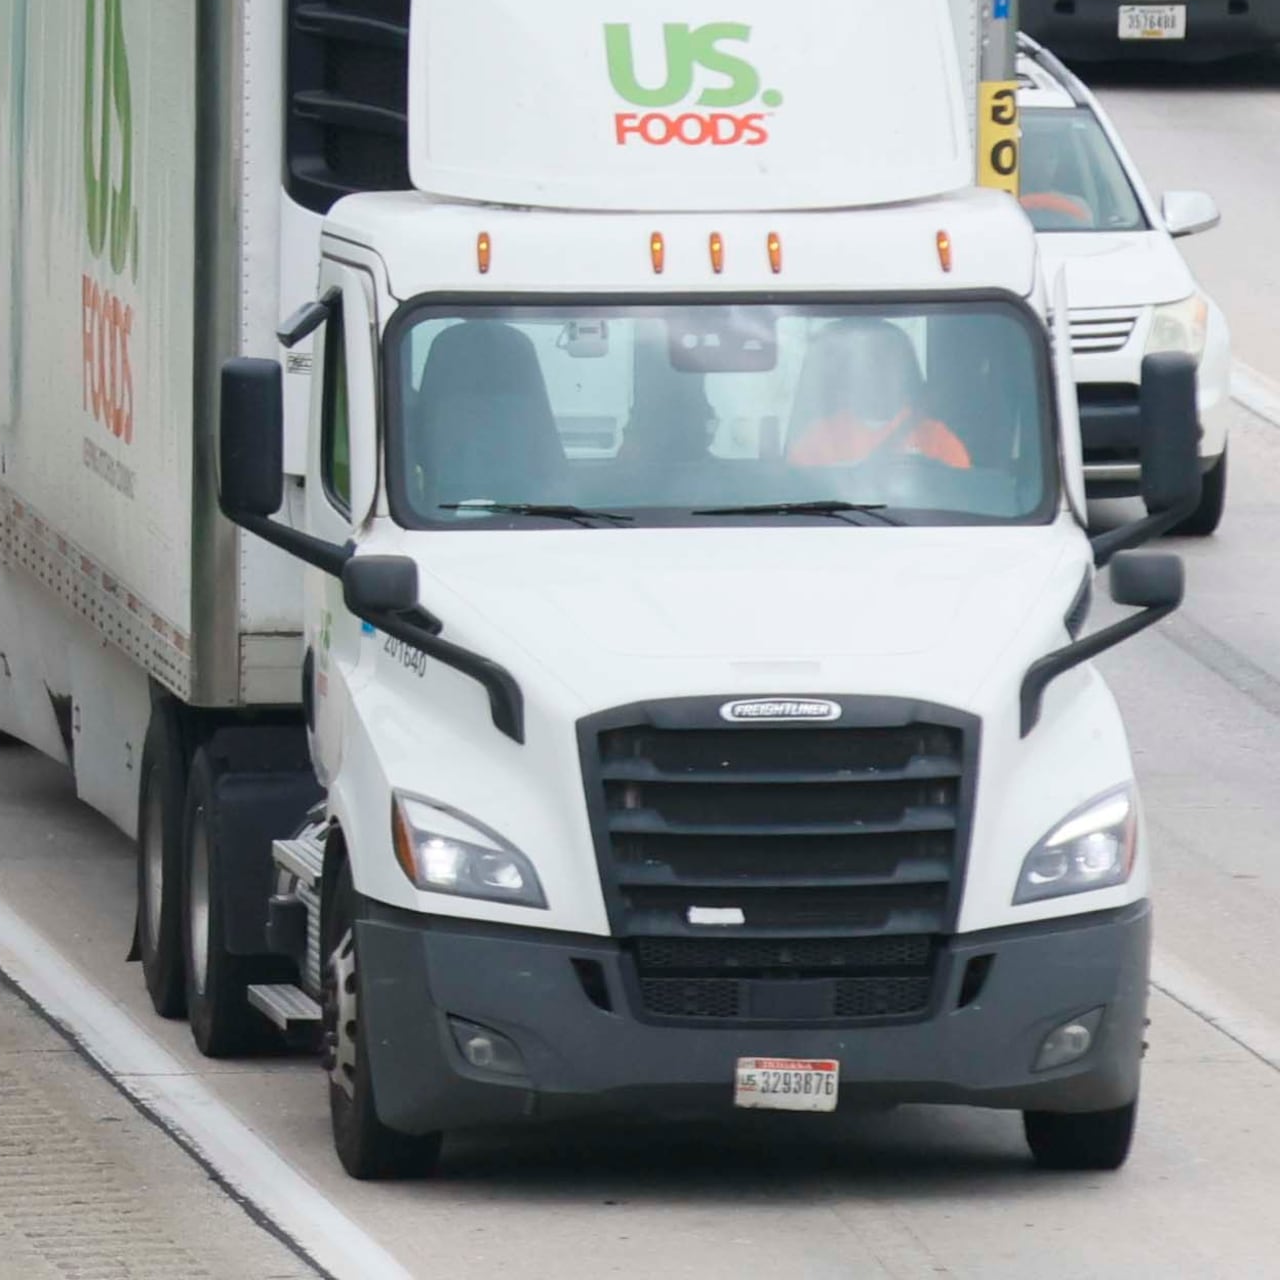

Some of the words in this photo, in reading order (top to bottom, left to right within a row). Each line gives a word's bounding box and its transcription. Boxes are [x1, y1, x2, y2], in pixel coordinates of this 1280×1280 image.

[615, 113, 769, 145] FOODS
[82, 273, 133, 446] FOODS
[733, 702, 830, 716] FREIGHTLINER
